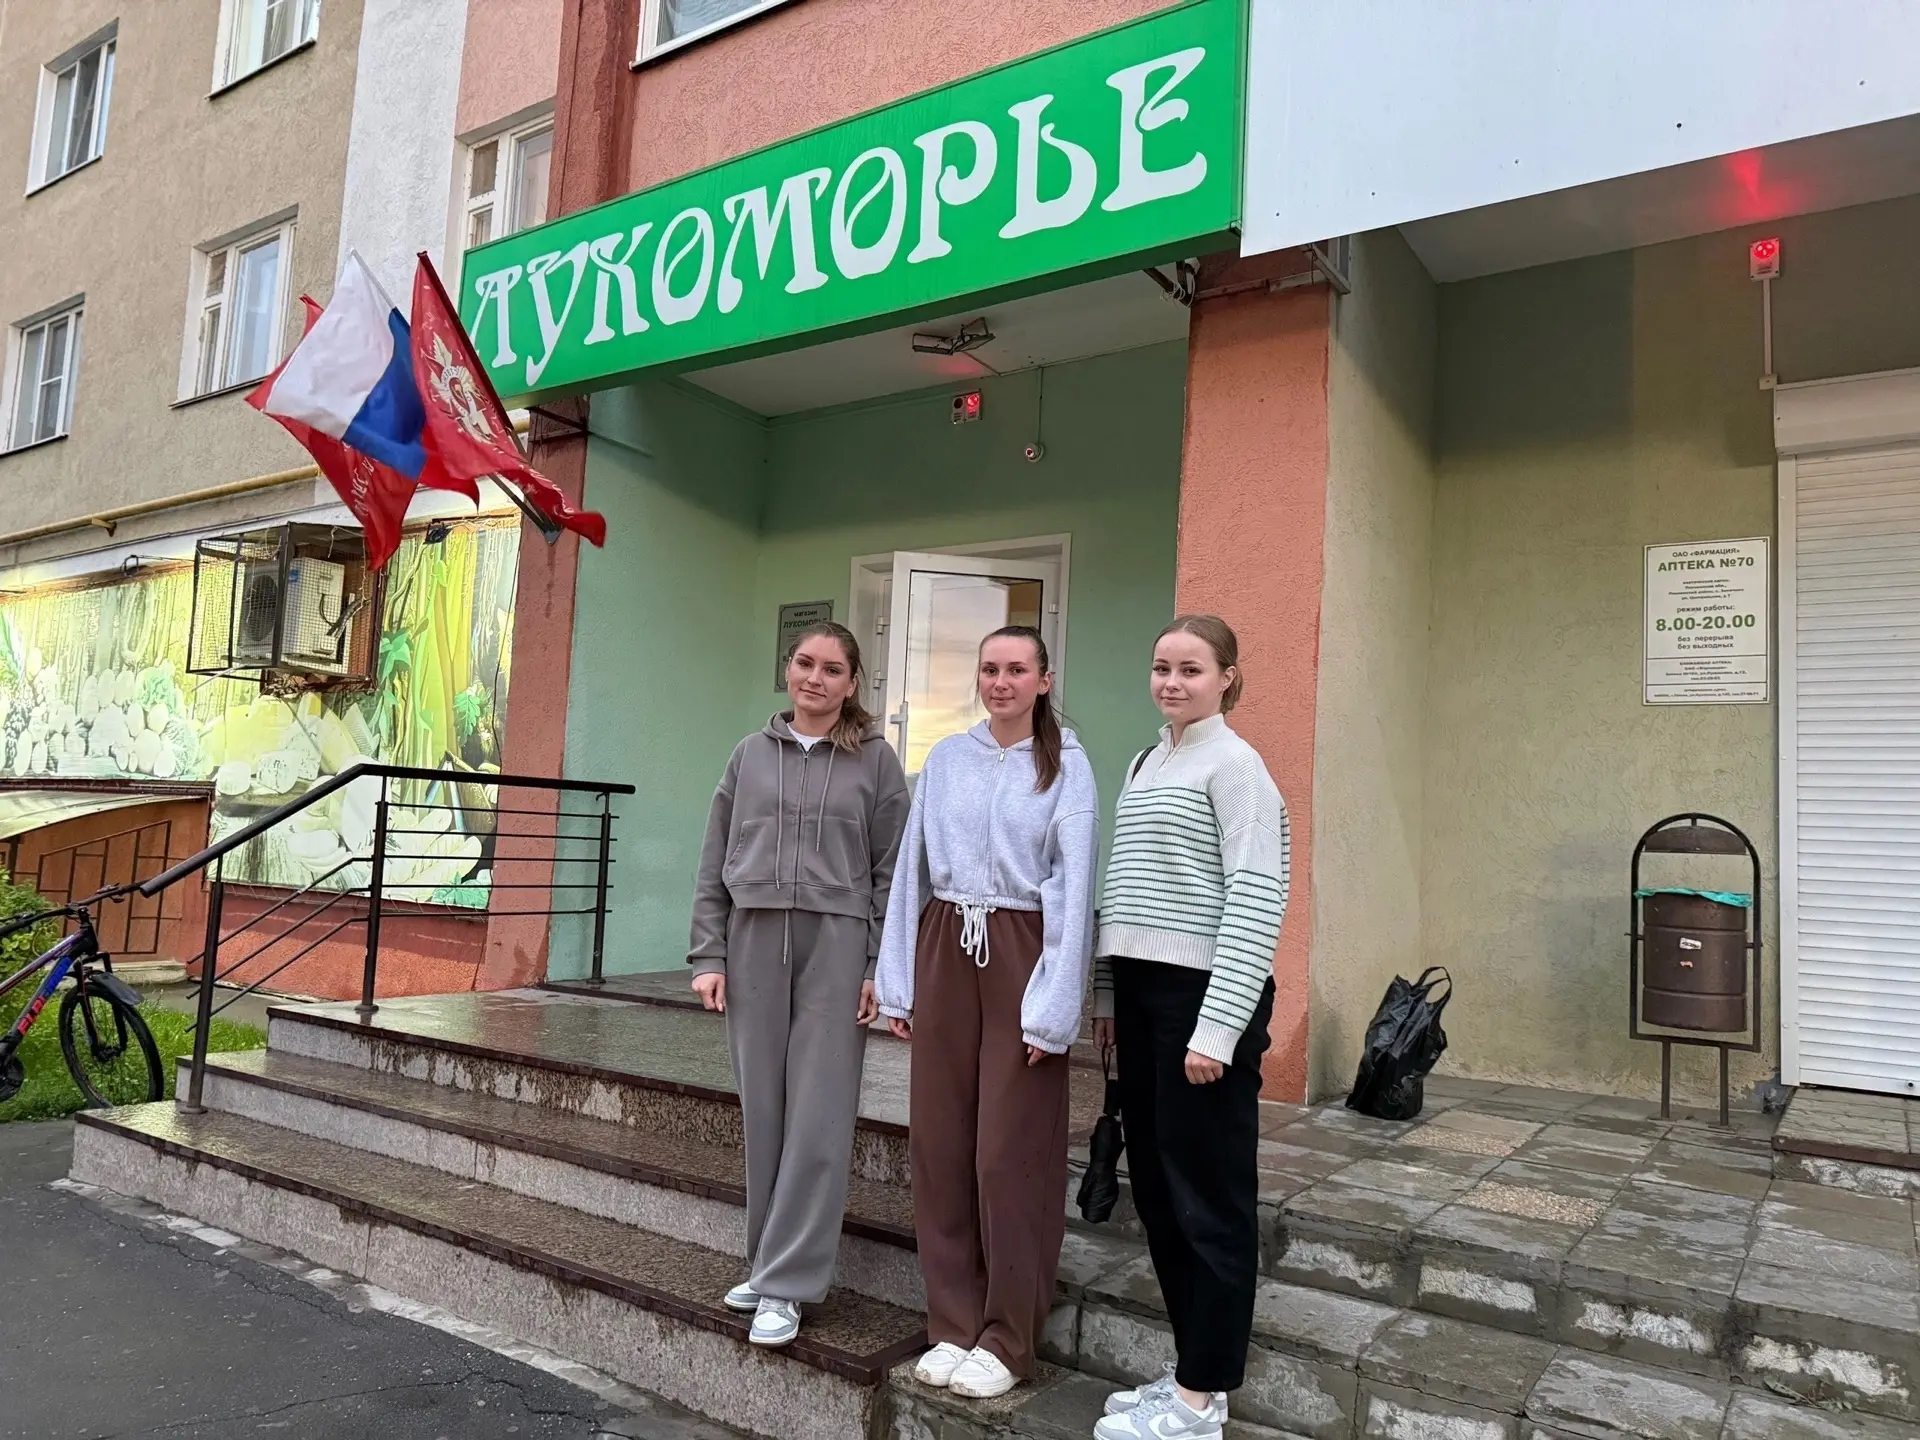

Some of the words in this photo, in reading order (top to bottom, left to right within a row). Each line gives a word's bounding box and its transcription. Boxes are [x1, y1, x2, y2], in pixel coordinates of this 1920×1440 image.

[469, 46, 1208, 387] ЛУКОМОРЬЕ
[1658, 559, 1715, 572] АПТЕКА
[1719, 556, 1754, 568] №70
[1703, 604, 1735, 612] работы:
[1656, 614, 1755, 631] 8.00-20.00
[1694, 634, 1734, 642] перерыва
